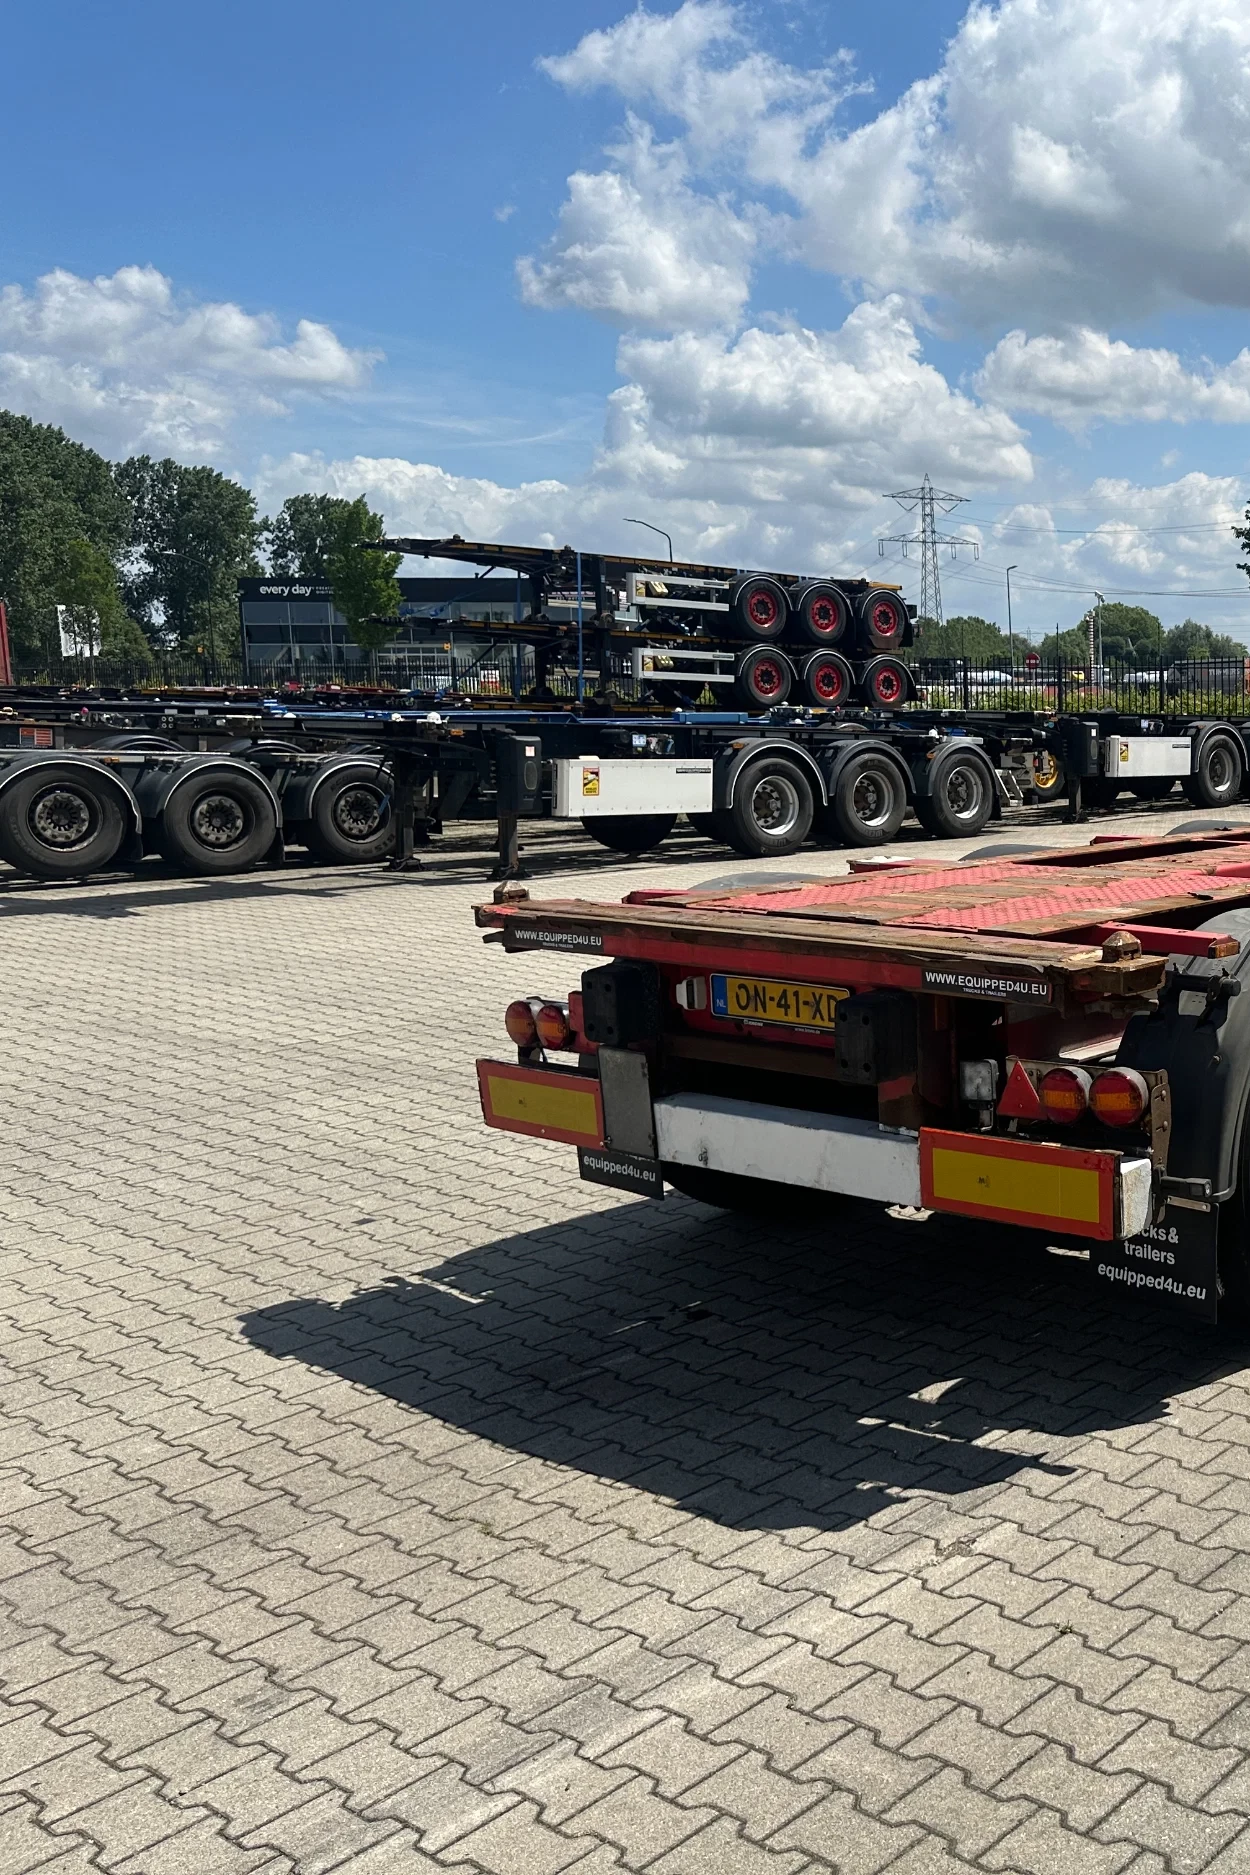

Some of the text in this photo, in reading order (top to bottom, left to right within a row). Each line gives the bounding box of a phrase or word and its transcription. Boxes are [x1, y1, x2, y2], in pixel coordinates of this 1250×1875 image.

[259, 584, 312, 597] every day
[514, 929, 602, 946] WWW.EQUIPPED4U.EU
[925, 971, 1047, 995] WWW.EQUIPPED4U.EU
[716, 998, 727, 1008] NL
[735, 982, 838, 1023] ON-41-XD
[583, 1155, 656, 1182] equipped4u.eu
[1167, 1227, 1179, 1244] &
[1124, 1240, 1176, 1265] trailers
[1097, 1263, 1207, 1300] equipped4u.eu
